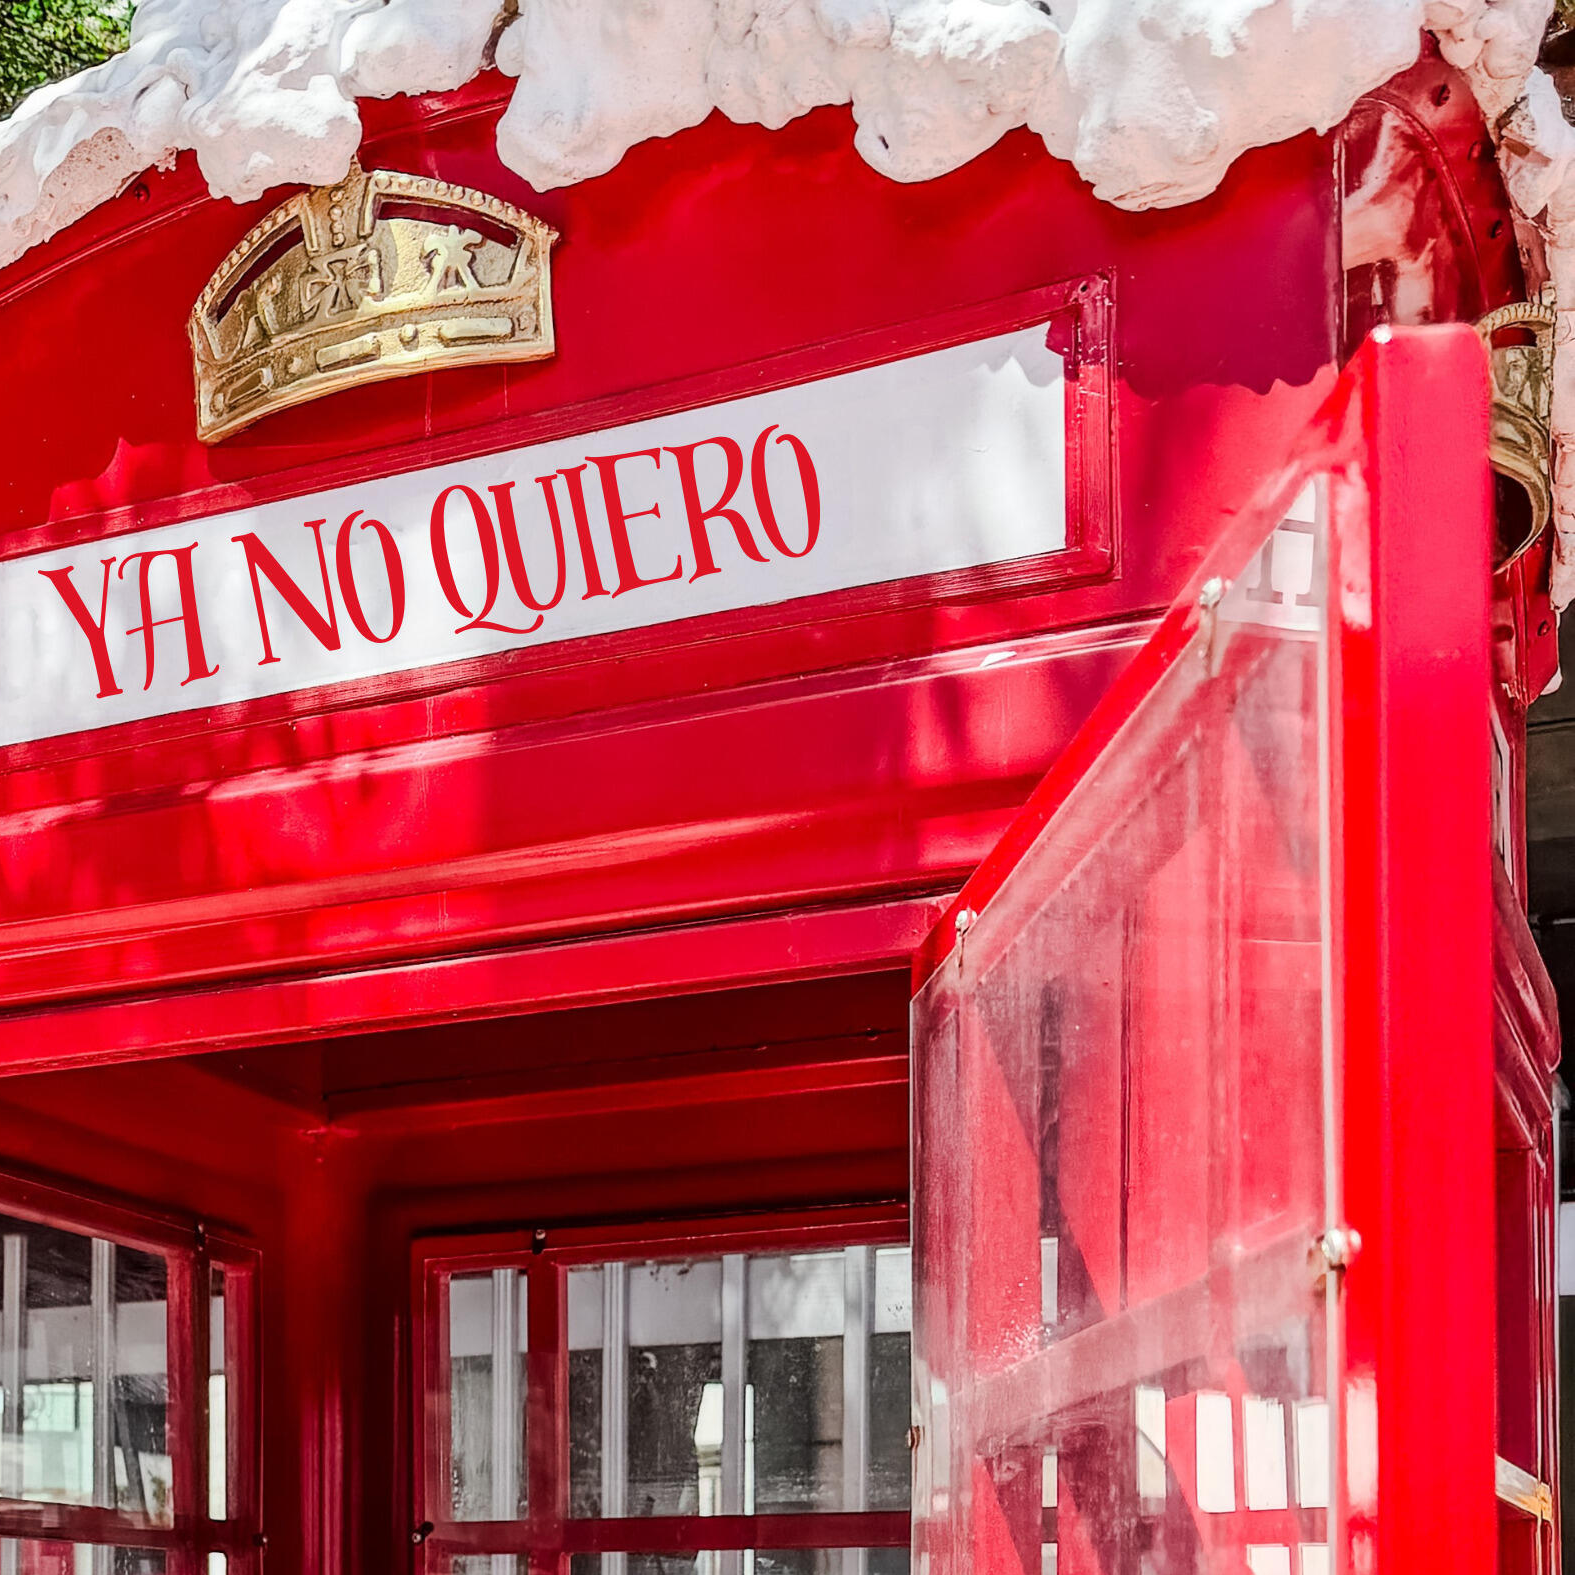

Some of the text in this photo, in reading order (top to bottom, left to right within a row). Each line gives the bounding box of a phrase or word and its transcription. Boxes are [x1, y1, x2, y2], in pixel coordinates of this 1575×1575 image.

[38, 424, 821, 698] YA NO QUIERO
